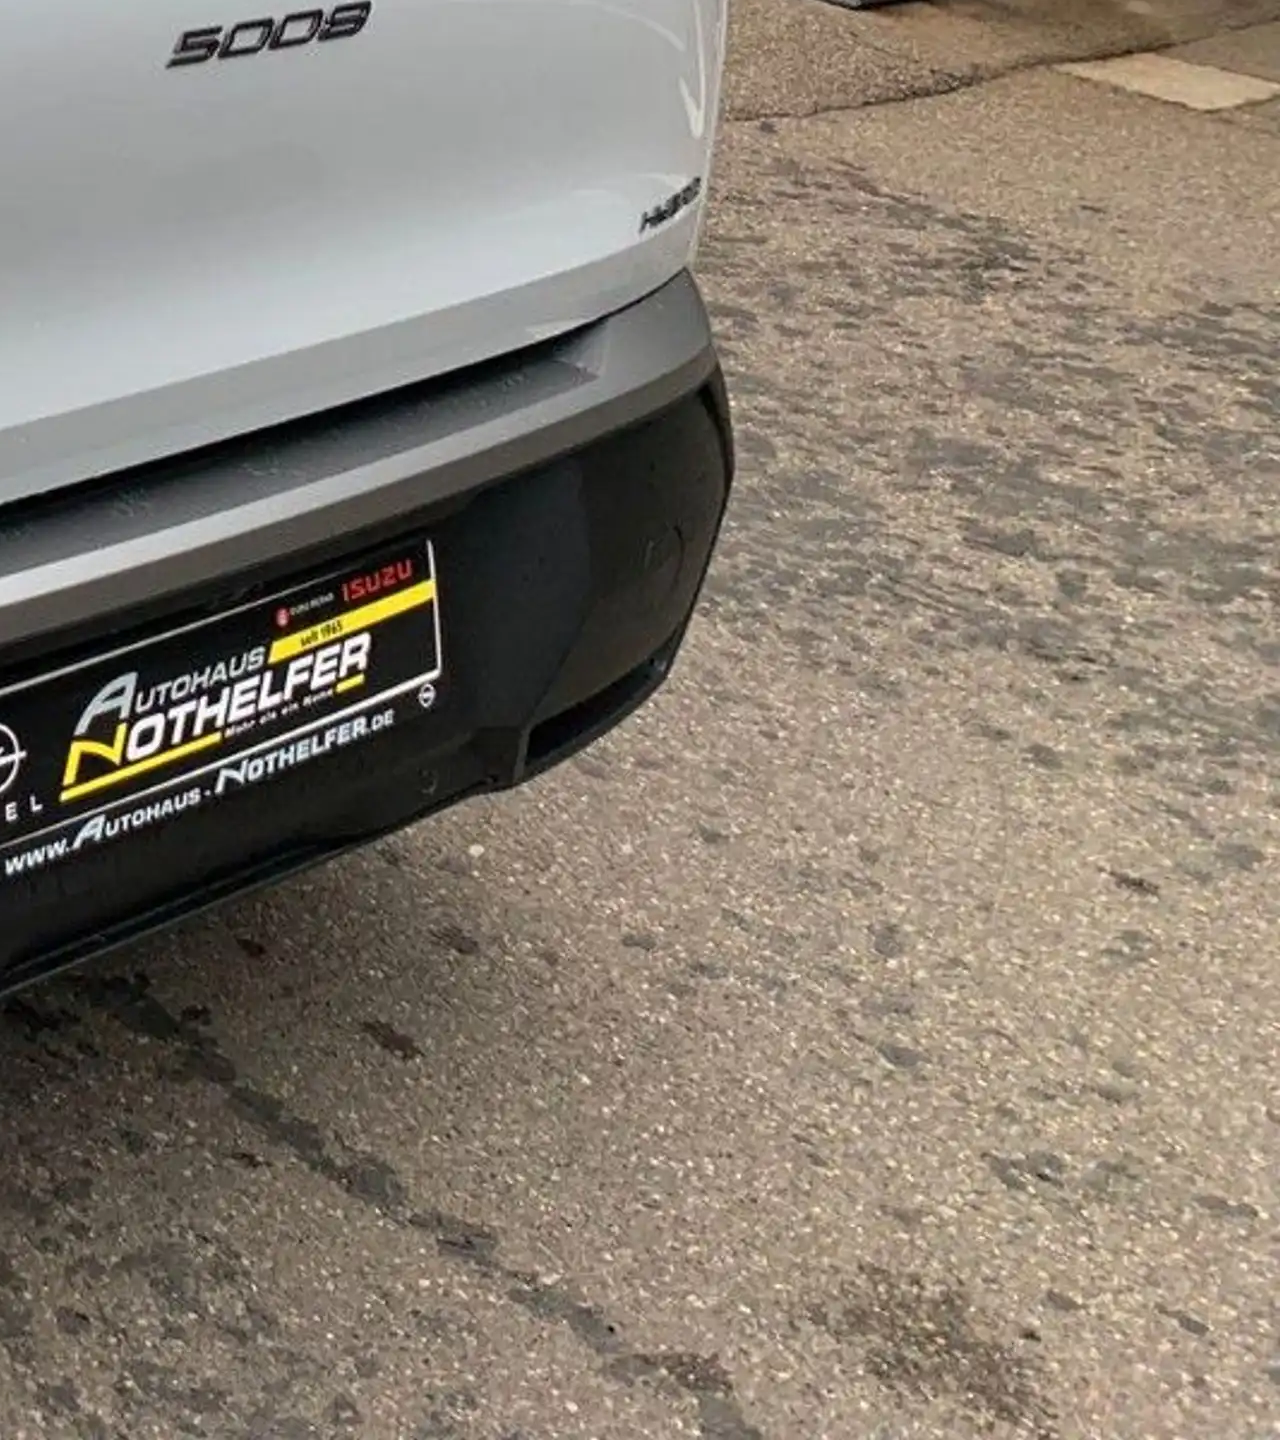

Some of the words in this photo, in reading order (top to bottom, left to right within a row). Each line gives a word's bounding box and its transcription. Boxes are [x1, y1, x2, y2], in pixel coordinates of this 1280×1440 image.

[166, 0, 372, 70] 5008
[341, 559, 414, 603] ISUZU
[61, 632, 372, 787] NOTHELFER
[73, 643, 266, 738] AUTOHAUS
